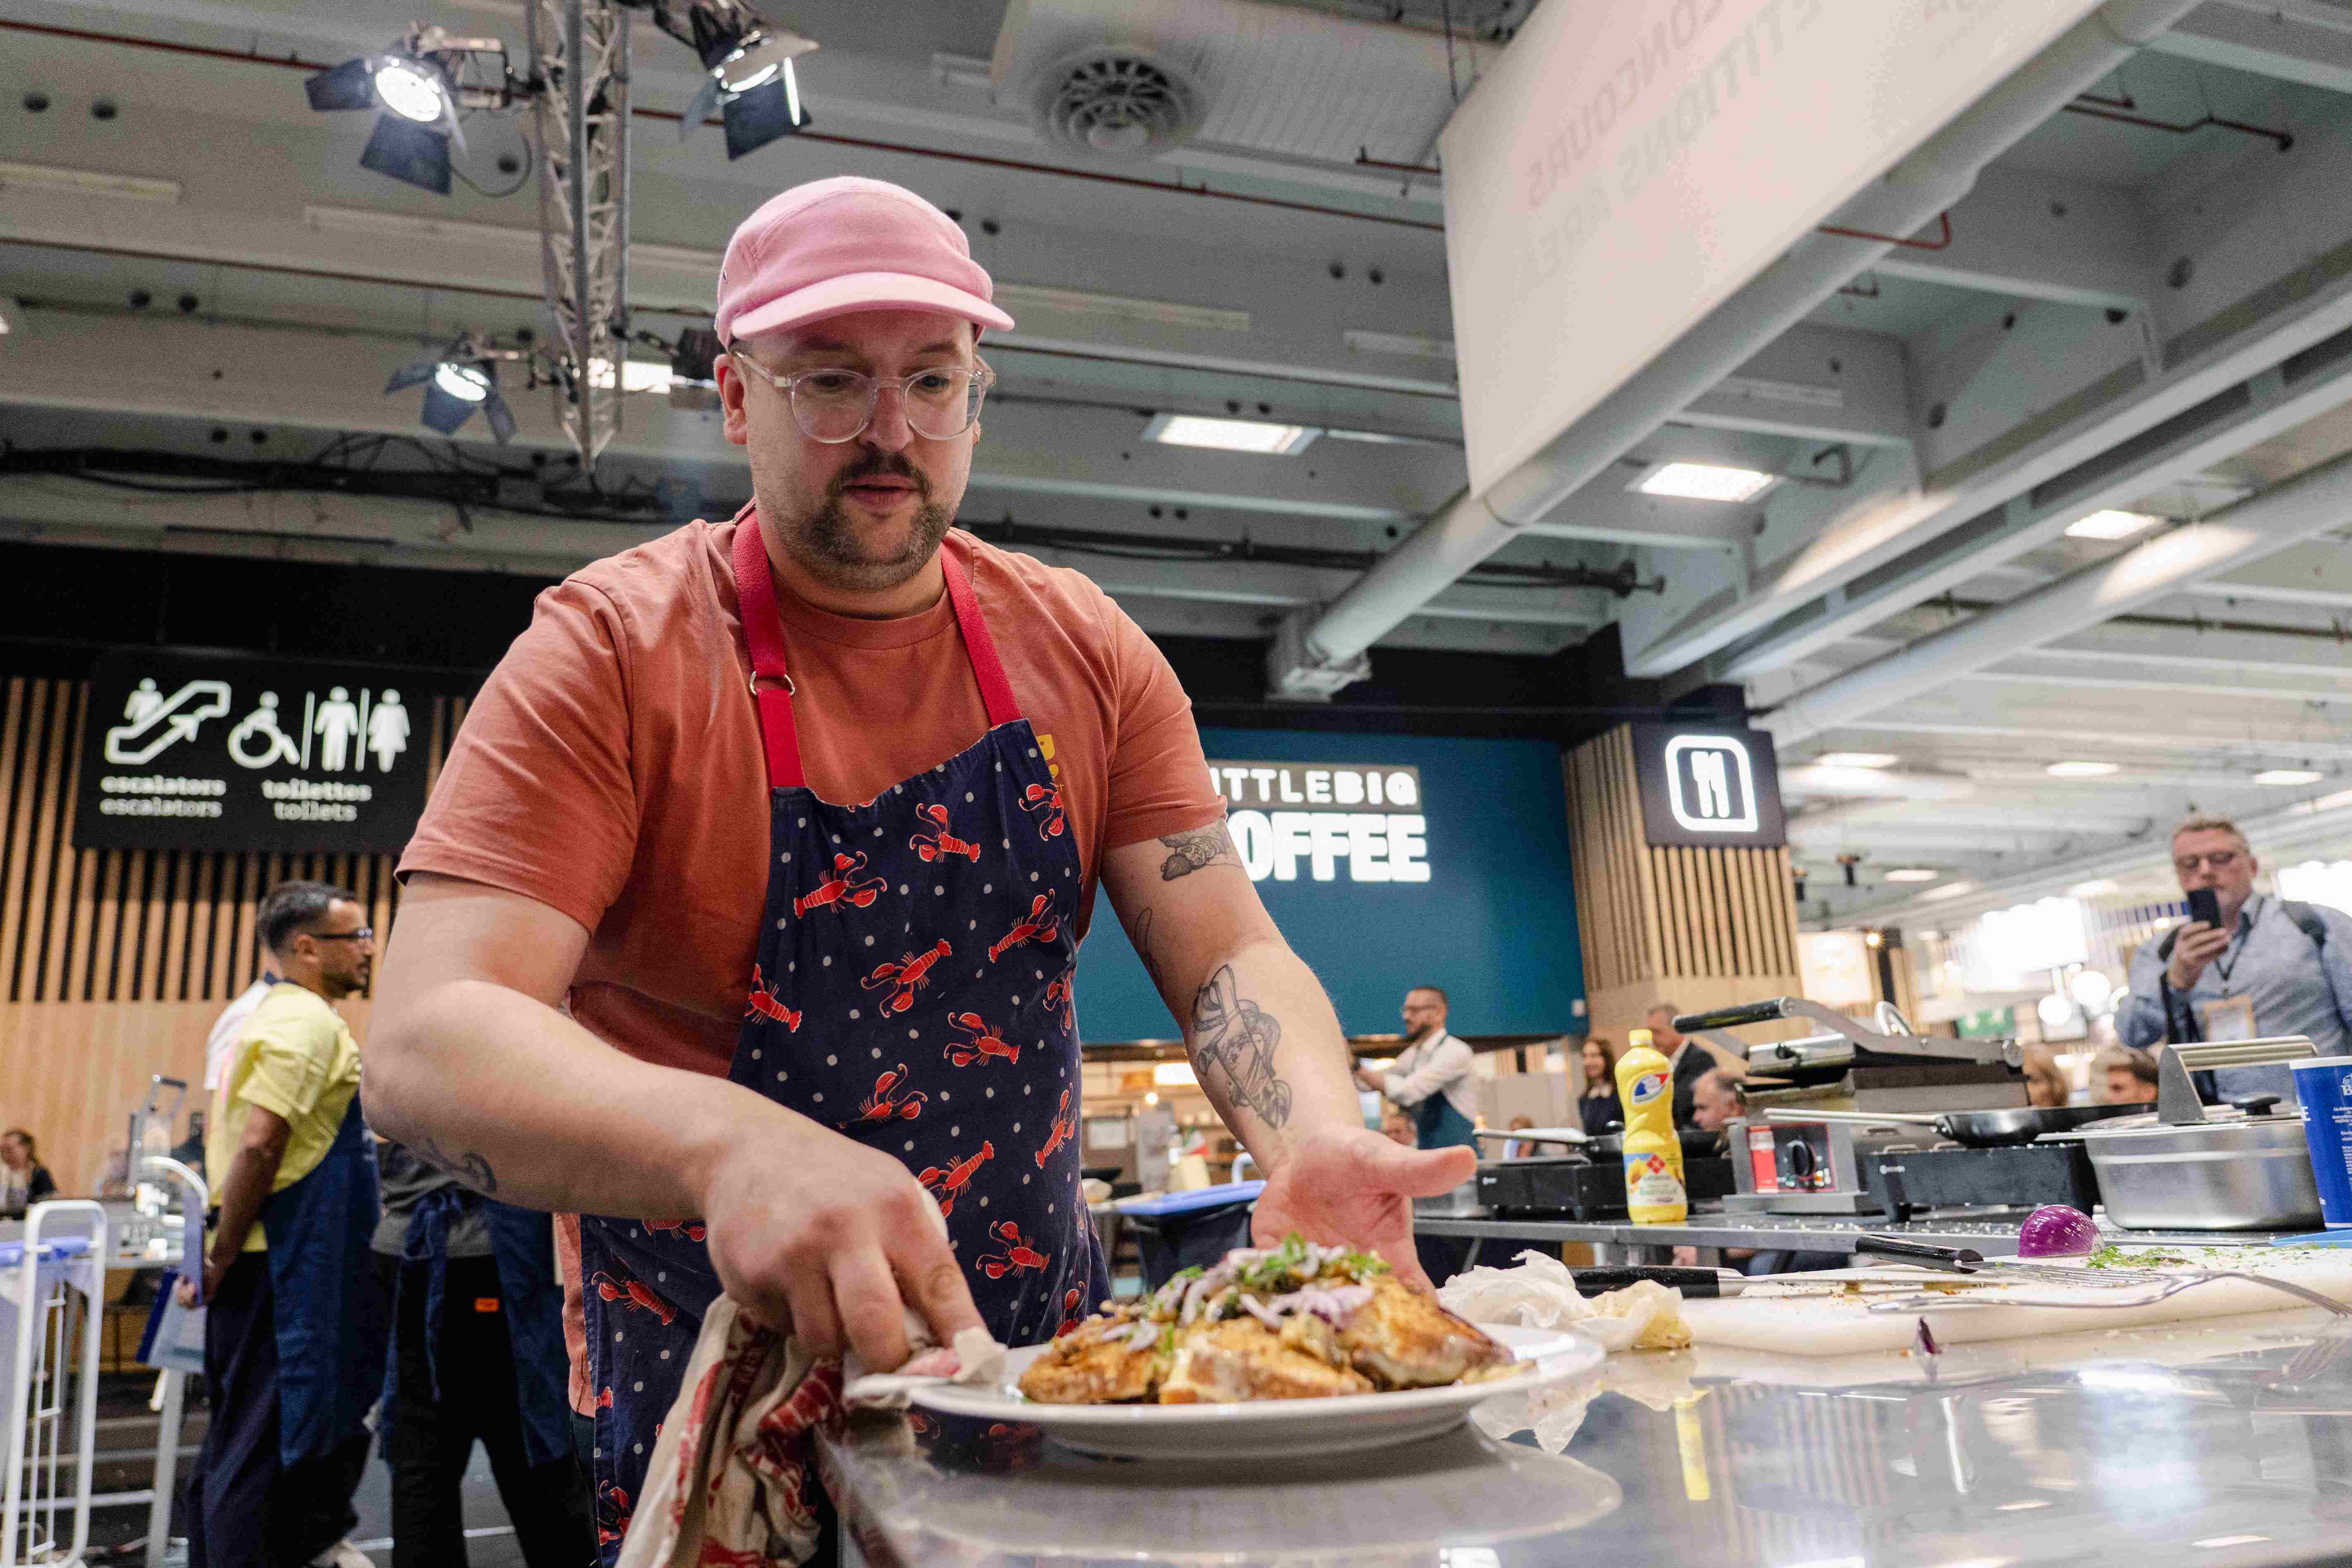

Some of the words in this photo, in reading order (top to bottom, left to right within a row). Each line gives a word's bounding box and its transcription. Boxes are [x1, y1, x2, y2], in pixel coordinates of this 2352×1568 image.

[100, 774, 227, 796] escalators
[262, 778, 372, 801] toilettes
[1209, 767, 1417, 806] ITTLEBIG
[100, 796, 222, 817] escalators
[274, 801, 357, 822] toilets
[1227, 810, 1431, 882] OFFEE
